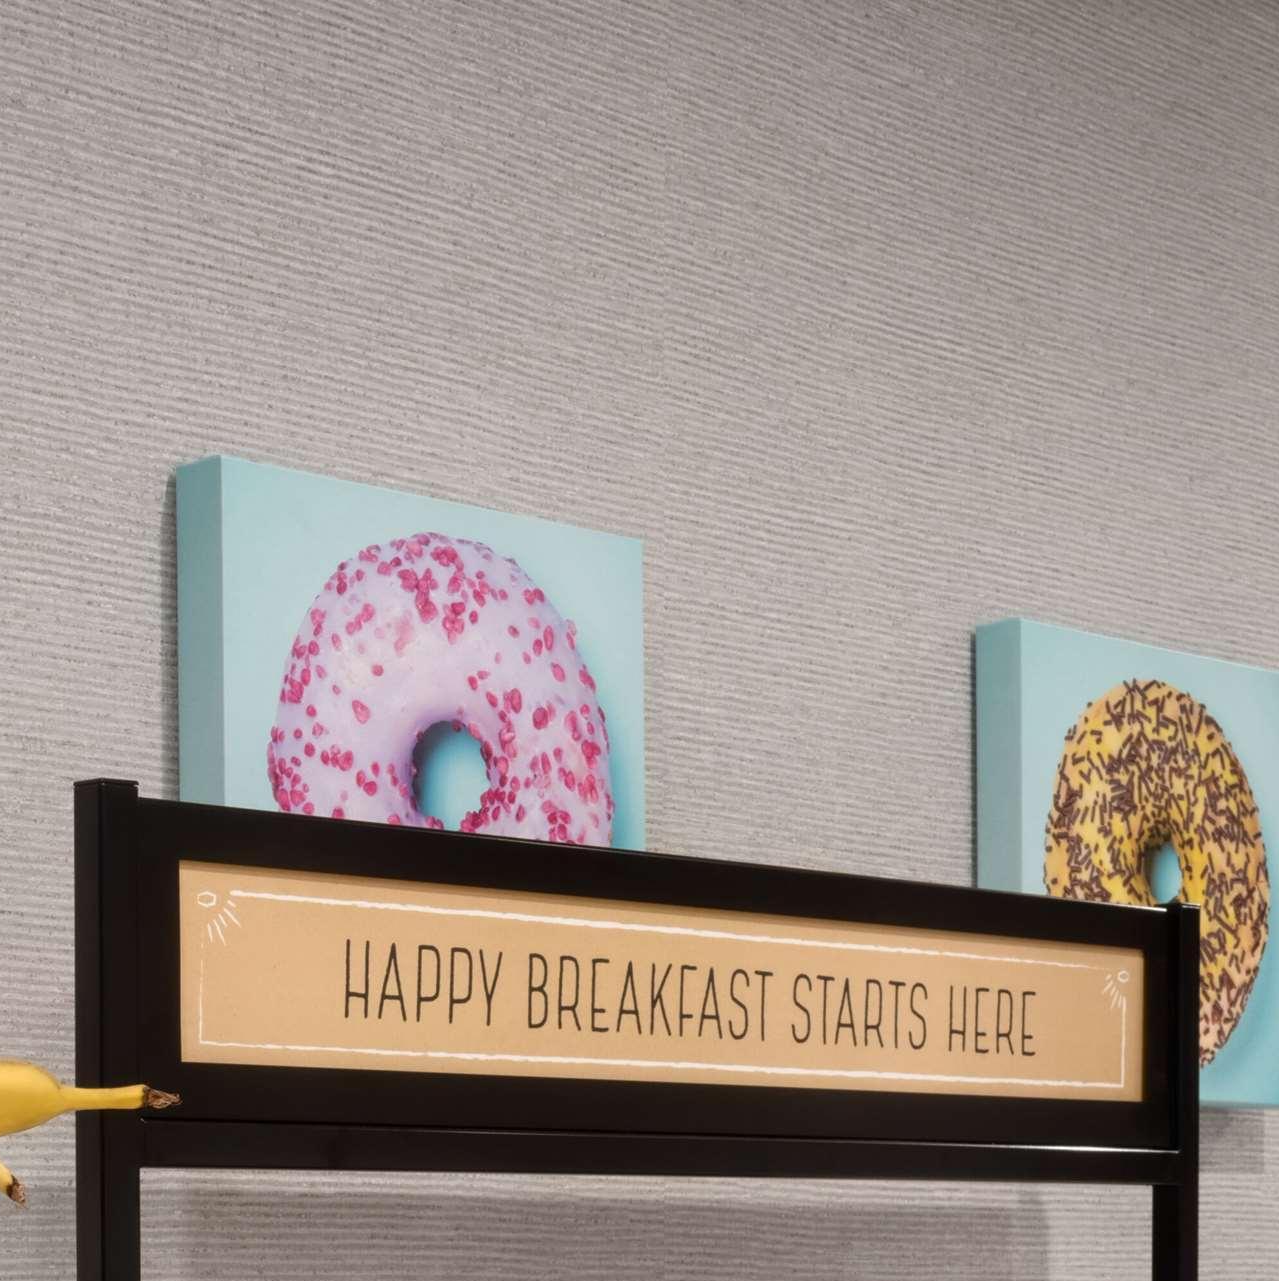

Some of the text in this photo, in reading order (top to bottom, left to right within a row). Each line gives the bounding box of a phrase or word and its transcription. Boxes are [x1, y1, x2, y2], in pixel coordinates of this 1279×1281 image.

[343, 937, 1038, 1058] HAPPY BREAKFAST STARTS HERE
